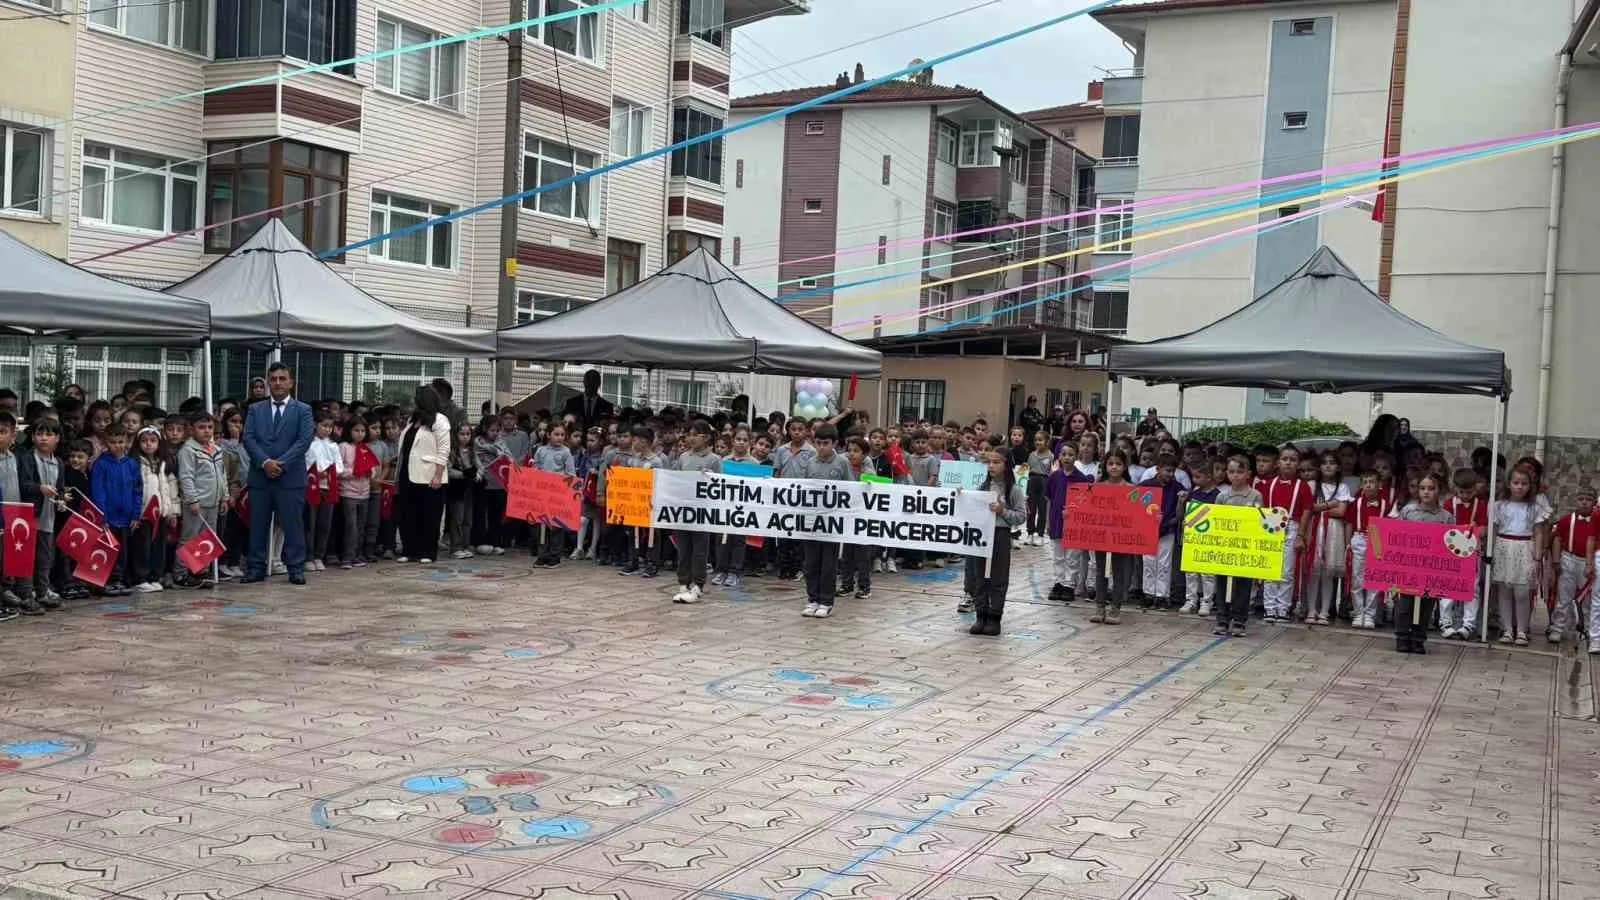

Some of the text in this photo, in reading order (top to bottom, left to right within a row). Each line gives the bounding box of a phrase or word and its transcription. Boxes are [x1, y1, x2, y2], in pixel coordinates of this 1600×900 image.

[772, 483, 851, 509] KÜLTÜR
[862, 491, 891, 512] VE
[902, 489, 957, 517] BİLGİ
[656, 503, 760, 529] AYDINLIĞA
[766, 512, 844, 537] AÇILAN
[853, 517, 988, 548] PENCEREDİR.
